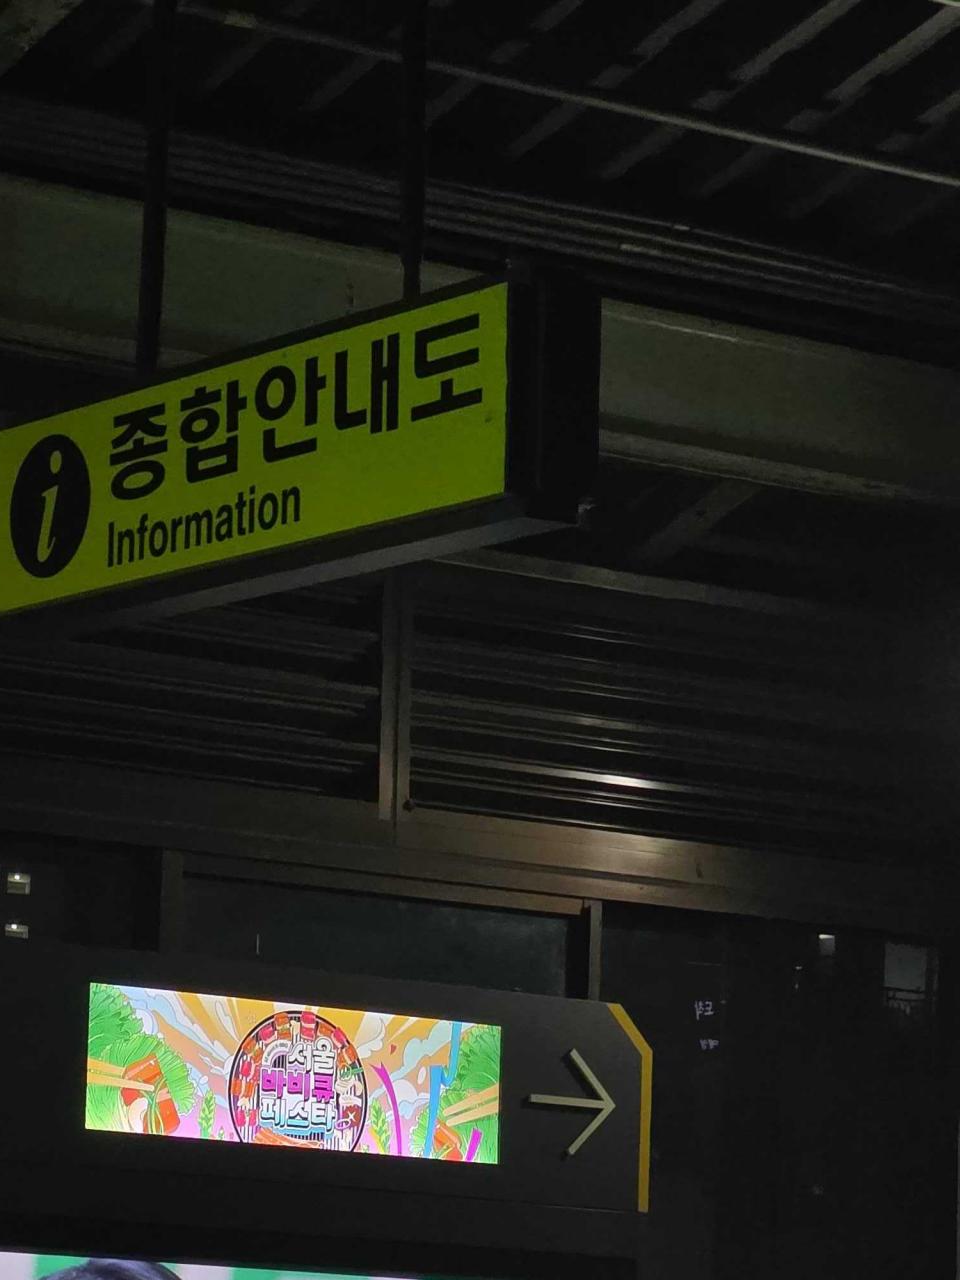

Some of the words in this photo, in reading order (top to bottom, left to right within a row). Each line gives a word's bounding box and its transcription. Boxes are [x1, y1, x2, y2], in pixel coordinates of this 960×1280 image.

[108, 313, 483, 501] 종합안내도
[106, 483, 301, 568] Information
[288, 1037, 335, 1076] 서울
[261, 1068, 335, 1105] 바비큐
[261, 1096, 336, 1132] 페스타
